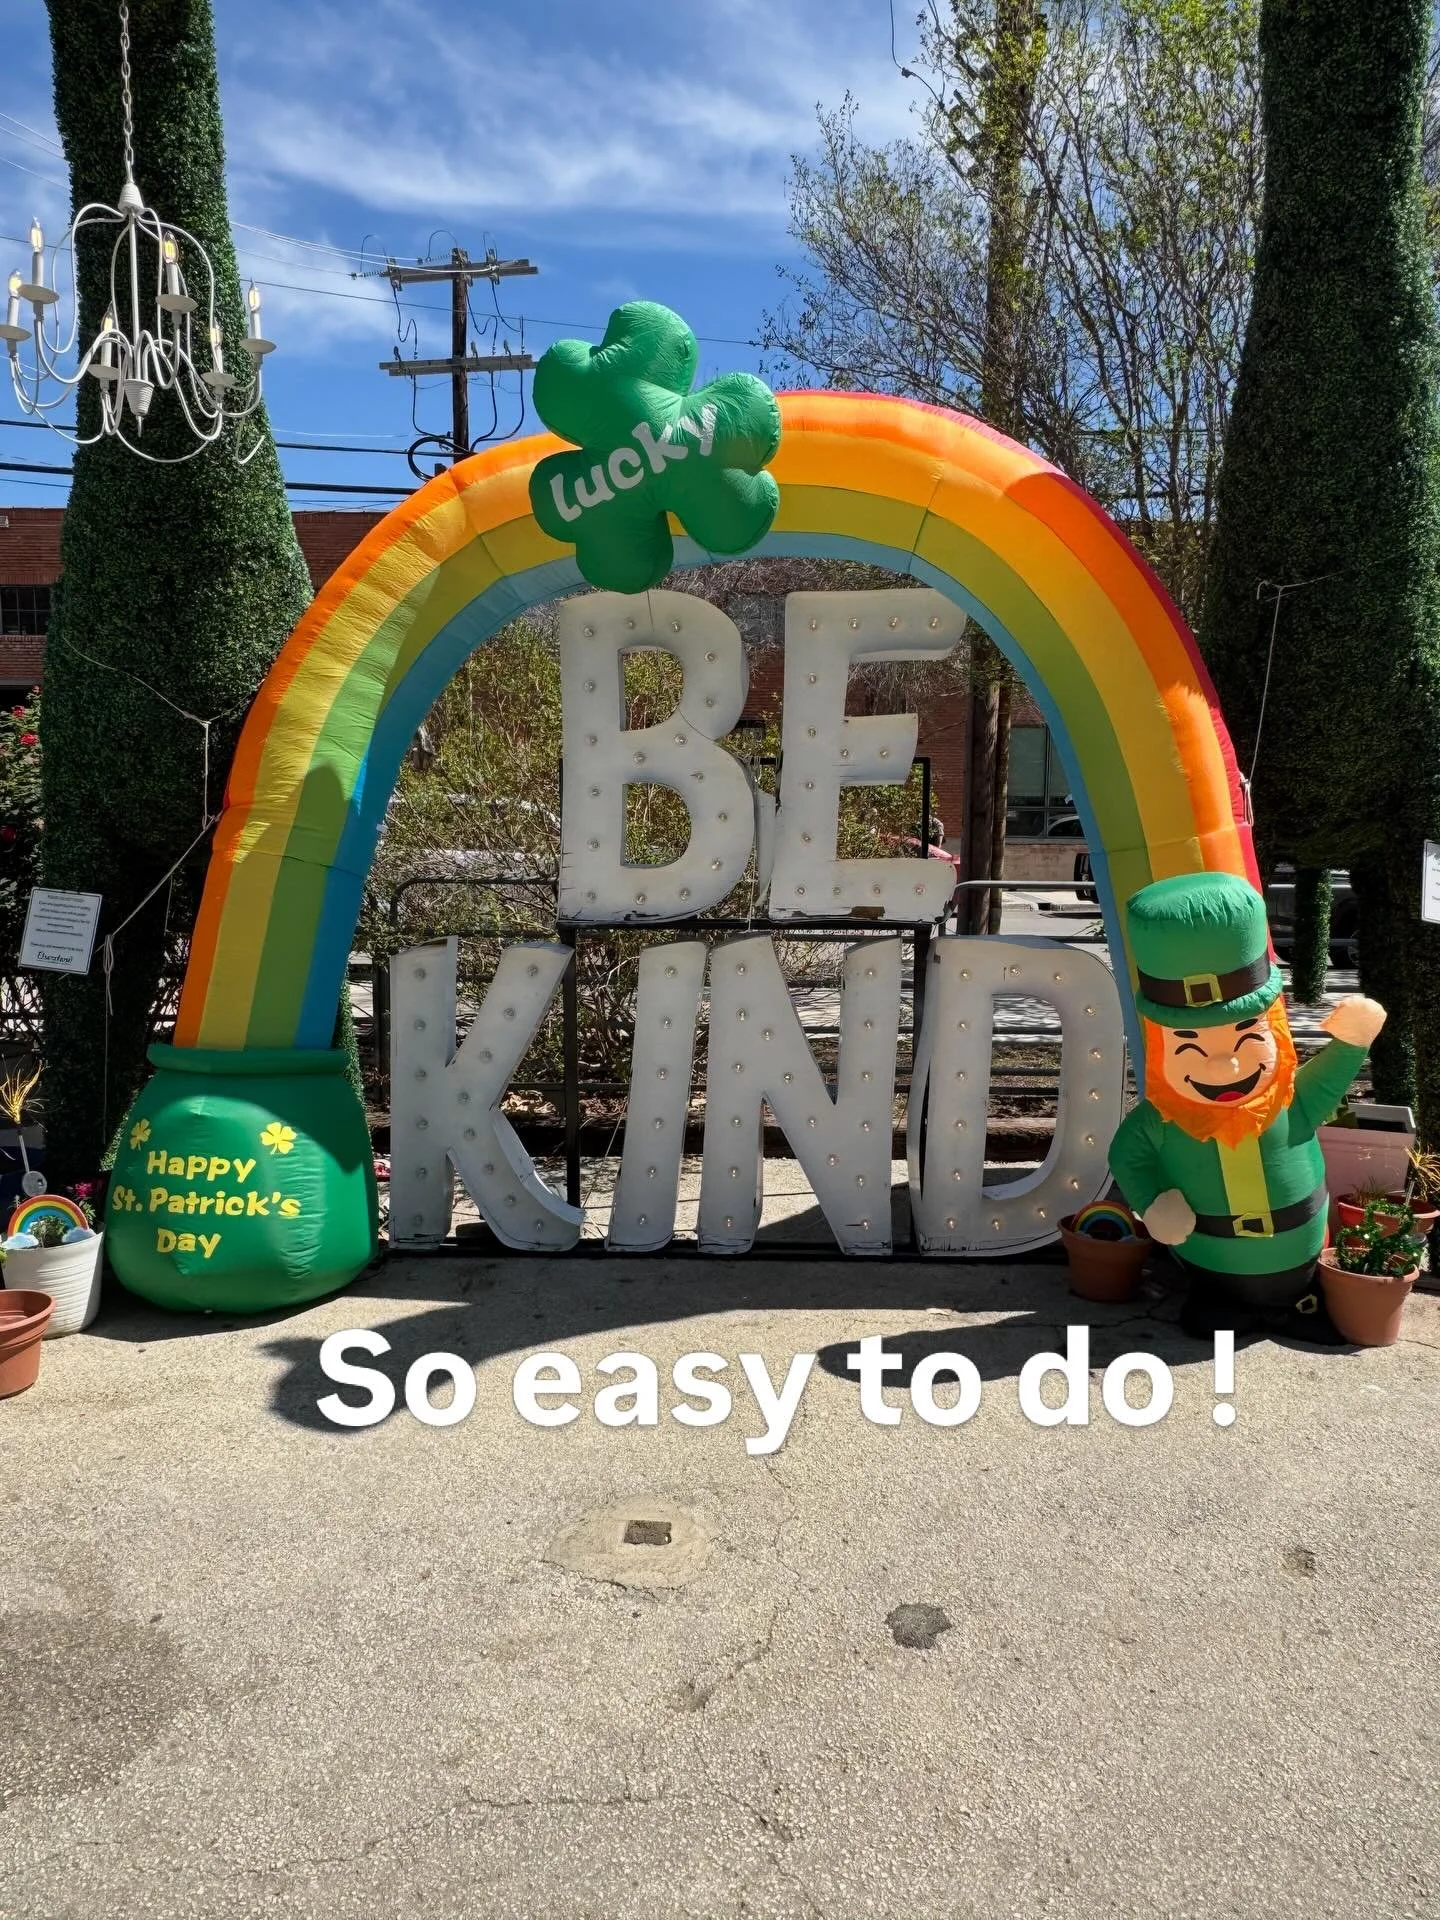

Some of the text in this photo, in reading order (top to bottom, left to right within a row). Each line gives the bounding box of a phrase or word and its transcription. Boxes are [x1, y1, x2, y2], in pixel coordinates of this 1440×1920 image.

[557, 589, 968, 923] BE
[389, 934, 1128, 1258] KIND
[147, 1150, 256, 1183] Happy
[112, 1185, 301, 1217] St. Patrick's
[156, 1227, 222, 1259] Day
